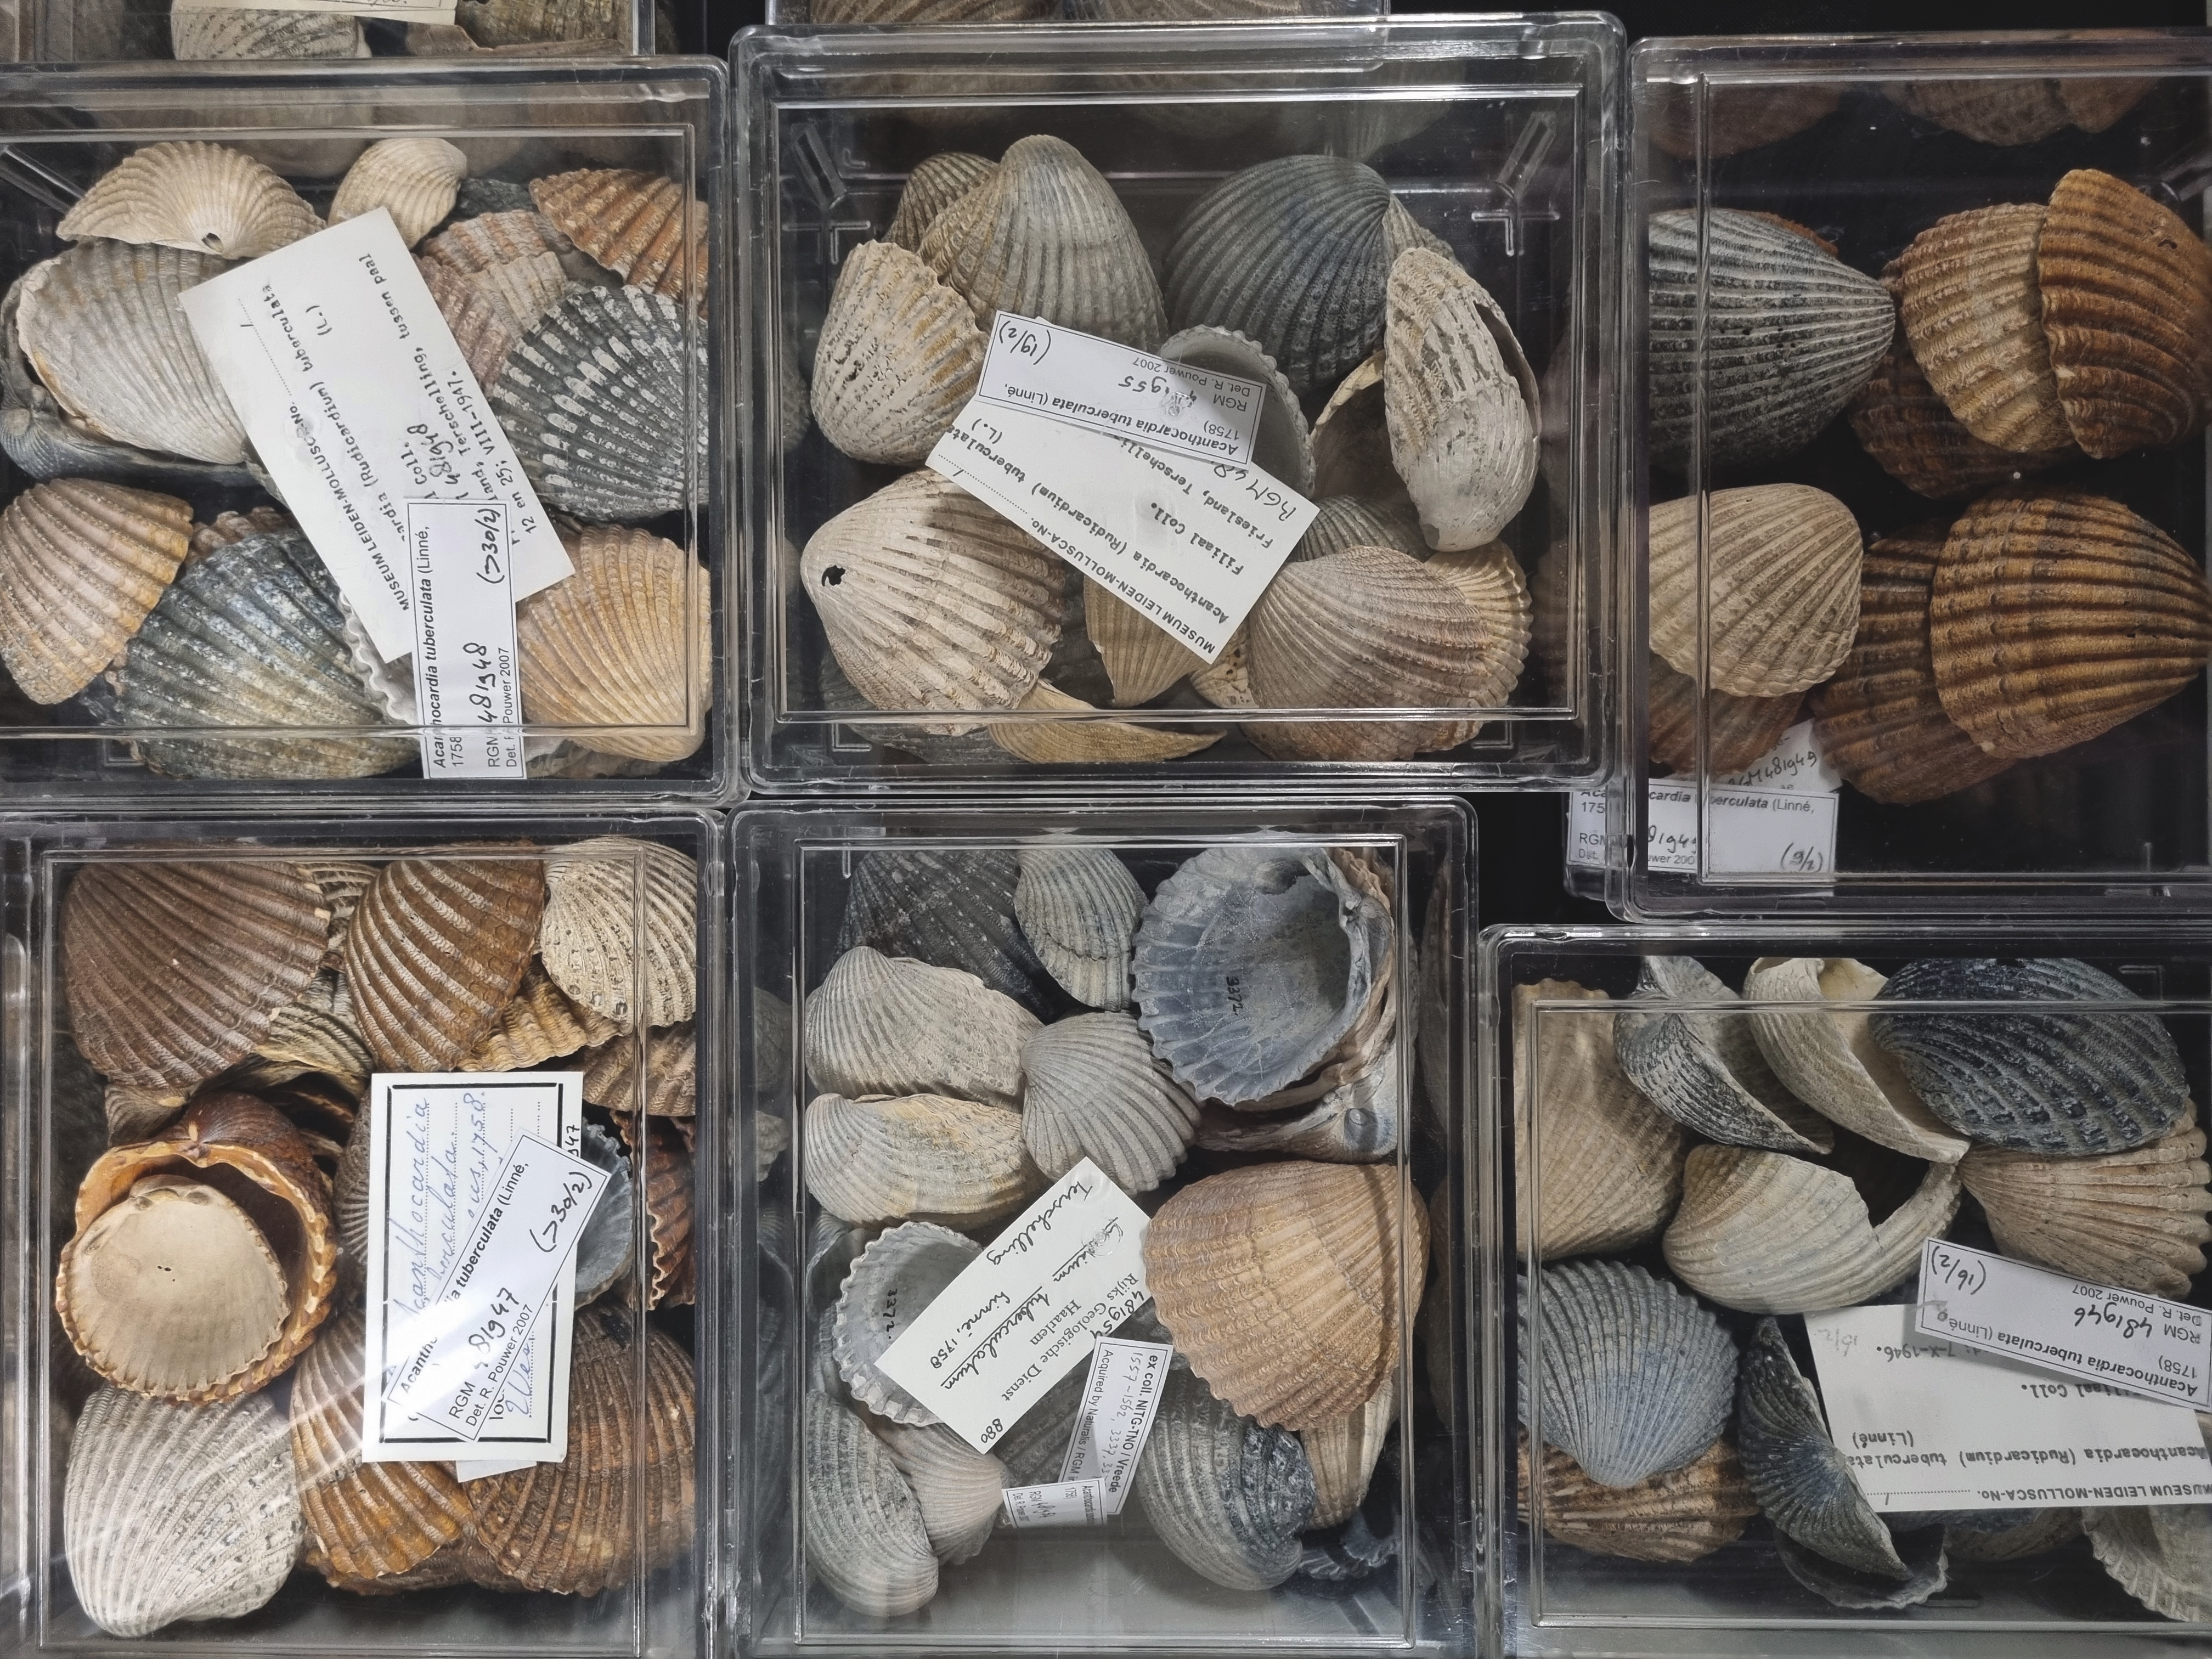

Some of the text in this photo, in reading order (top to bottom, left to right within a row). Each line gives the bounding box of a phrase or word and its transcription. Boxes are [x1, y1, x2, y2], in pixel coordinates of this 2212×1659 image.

[358, 252, 388, 285] paal
[262, 283, 314, 373] tuberculata
[305, 304, 333, 336] (L.)
[380, 290, 410, 340] tussen
[998, 319, 1052, 366] (19/2)
[1117, 375, 1248, 413] RGM 41955
[1131, 357, 1251, 398] Det. R. Pouwer 2007
[413, 346, 472, 458] Terschelling,
[1004, 382, 1239, 456] Acanthocardia tuberculata (Linné,
[308, 381, 380, 488] (Rudicardium)
[446, 370, 538, 535] 12 en 25; VIII-1947.
[970, 417, 1003, 445] (L.)
[1203, 420, 1240, 442] 1758)
[400, 441, 428, 486] Coll.
[405, 422, 461, 486] 481948
[1103, 426, 1274, 549] Friesland, Terschelli
[1245, 478, 1297, 522] RGM
[1030, 482, 1128, 556] (Rudicardium)
[1150, 501, 1245, 576] Filiaal Coll.
[414, 526, 434, 574] (Linné,
[371, 552, 410, 612] MUSEUM
[1030, 517, 1216, 654] MUSEUM LEIDEN-MOLLUSCA-No.
[1132, 550, 1230, 625] Acanthocardia
[419, 578, 437, 661] tuberculata
[461, 641, 499, 724] 481948
[497, 646, 511, 677] 2007
[425, 665, 447, 769] Acahocardia
[501, 679, 514, 724] Pouwer
[448, 736, 465, 768] 1758
[504, 743, 518, 768] Det.
[1771, 798, 1814, 815] (Linné,
[455, 1207, 504, 1288] tuberculata
[496, 1163, 529, 1206] (Linné,
[985, 1181, 1094, 1266] Terschelling
[1924, 1245, 1987, 1296] (16/2)
[940, 1218, 1124, 1390] Cadium tuberculatum
[1029, 1299, 1082, 1346] Haarlem
[2071, 1284, 2203, 1328] Det. R. Pouwer 2007
[2073, 1291, 2202, 1345] RGM 481946
[1001, 1272, 1139, 1402] Rijks Geologische Dienst
[1948, 1317, 1994, 1341] (Linné
[1996, 1331, 2083, 1365] tuberculata
[448, 1288, 523, 1420] RGM 81947
[465, 1303, 533, 1427] Det. R. Pouwer 2007
[929, 1338, 958, 1370] 1758
[1093, 1348, 1115, 1393] Acquired
[1146, 1354, 1159, 1370] ex
[2086, 1356, 2199, 1397] Acanthocardia
[2158, 1354, 2198, 1380] 1758)
[1087, 1395, 1103, 1407] by
[1138, 1372, 1154, 1397] coll.
[2021, 1384, 2068, 1399] Coll.
[980, 1417, 1004, 1444] 880
[1077, 1407, 1099, 1446] Naturalis
[1122, 1399, 1149, 1451] NITG-TNO
[1852, 1429, 1915, 1450] (Linné)
[1069, 1452, 1086, 1475] RGM
[1108, 1458, 1131, 1493] Vreede
[1959, 1447, 2076, 1469] (Rudicardium)
[1977, 1485, 2147, 1502] LEIDEN-MOLLUSCA-No.
